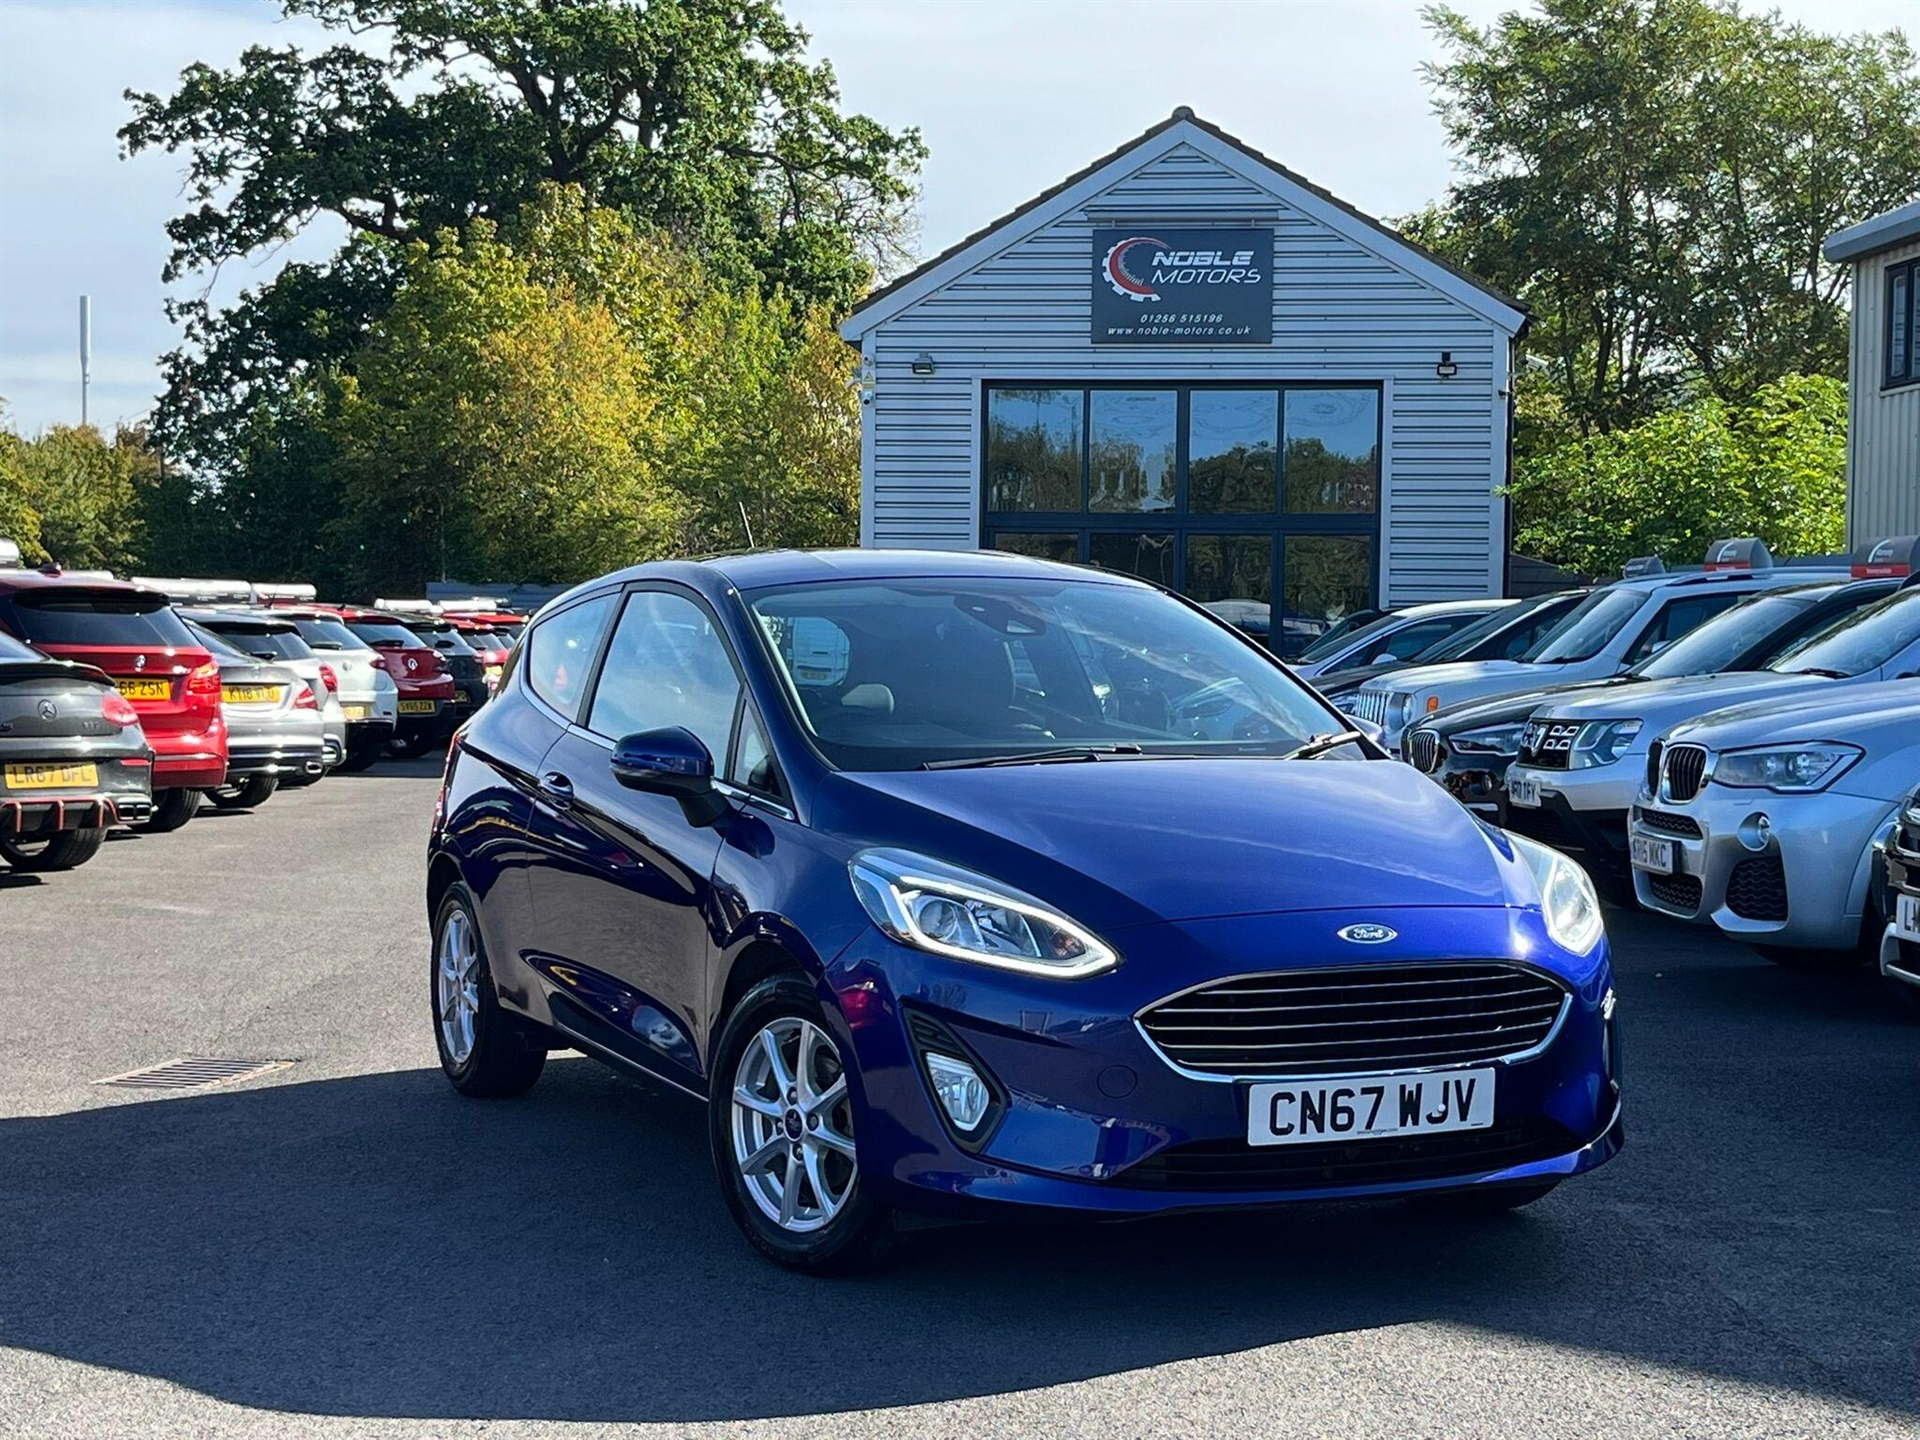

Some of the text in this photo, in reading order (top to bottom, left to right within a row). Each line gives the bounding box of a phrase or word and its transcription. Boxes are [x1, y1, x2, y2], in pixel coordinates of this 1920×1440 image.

[1151, 251, 1255, 266] NOBLE
[1151, 268, 1262, 284] MOTORS
[1140, 314, 1224, 323] 01256 515196
[1107, 326, 1252, 336] www.noble-motors.co.uk
[140, 681, 165, 696] ZSN
[12, 764, 92, 784] LR67 DFL
[1353, 927, 1385, 939] Ford
[1269, 1078, 1477, 1136] CN67 WJV
